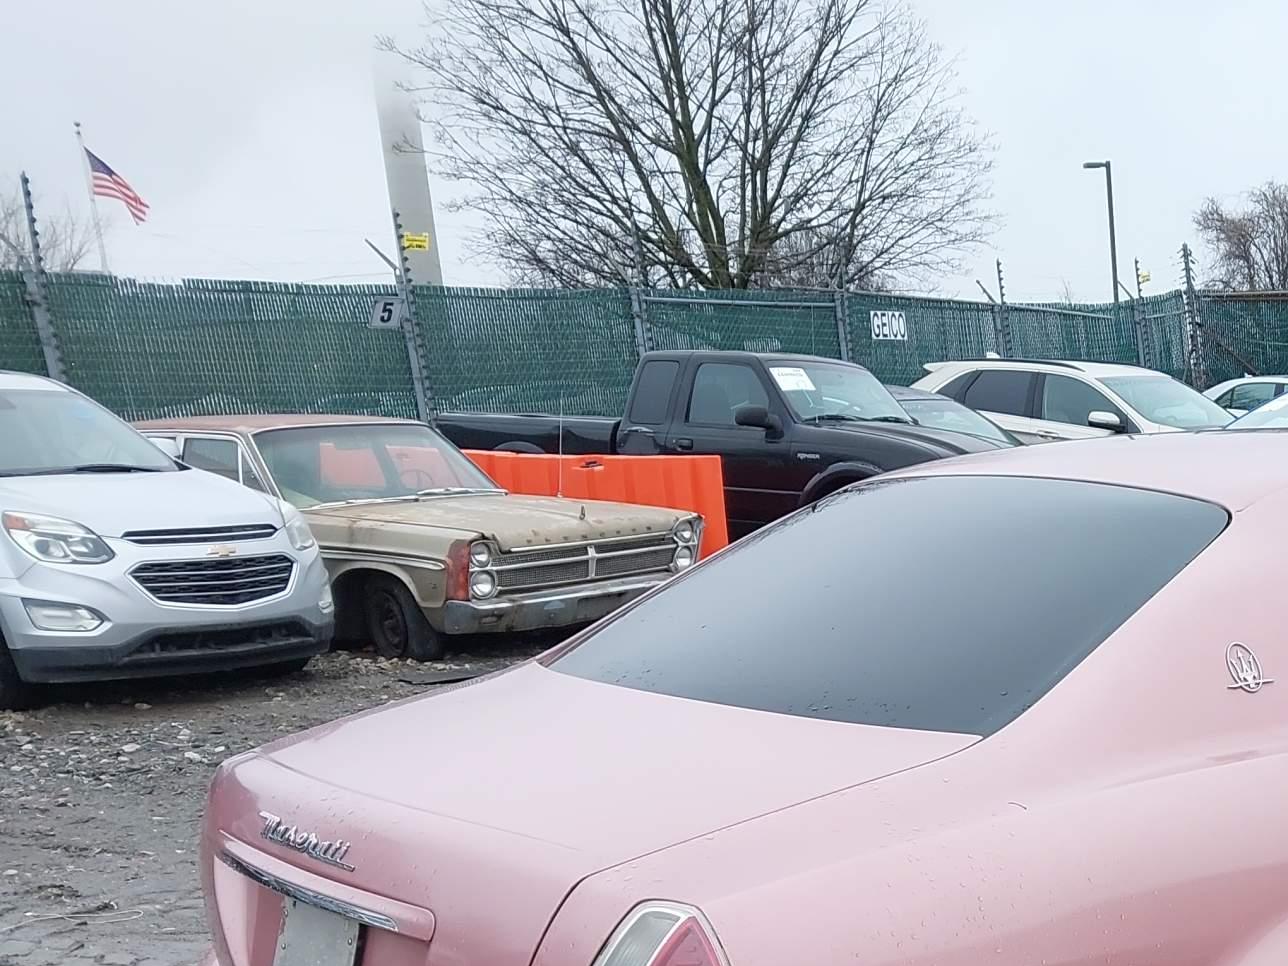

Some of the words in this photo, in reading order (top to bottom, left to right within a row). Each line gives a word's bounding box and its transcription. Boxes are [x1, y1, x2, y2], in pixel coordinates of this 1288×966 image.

[380, 302, 394, 323] 5
[872, 312, 906, 338] GEICO
[259, 811, 355, 872] Maserati
